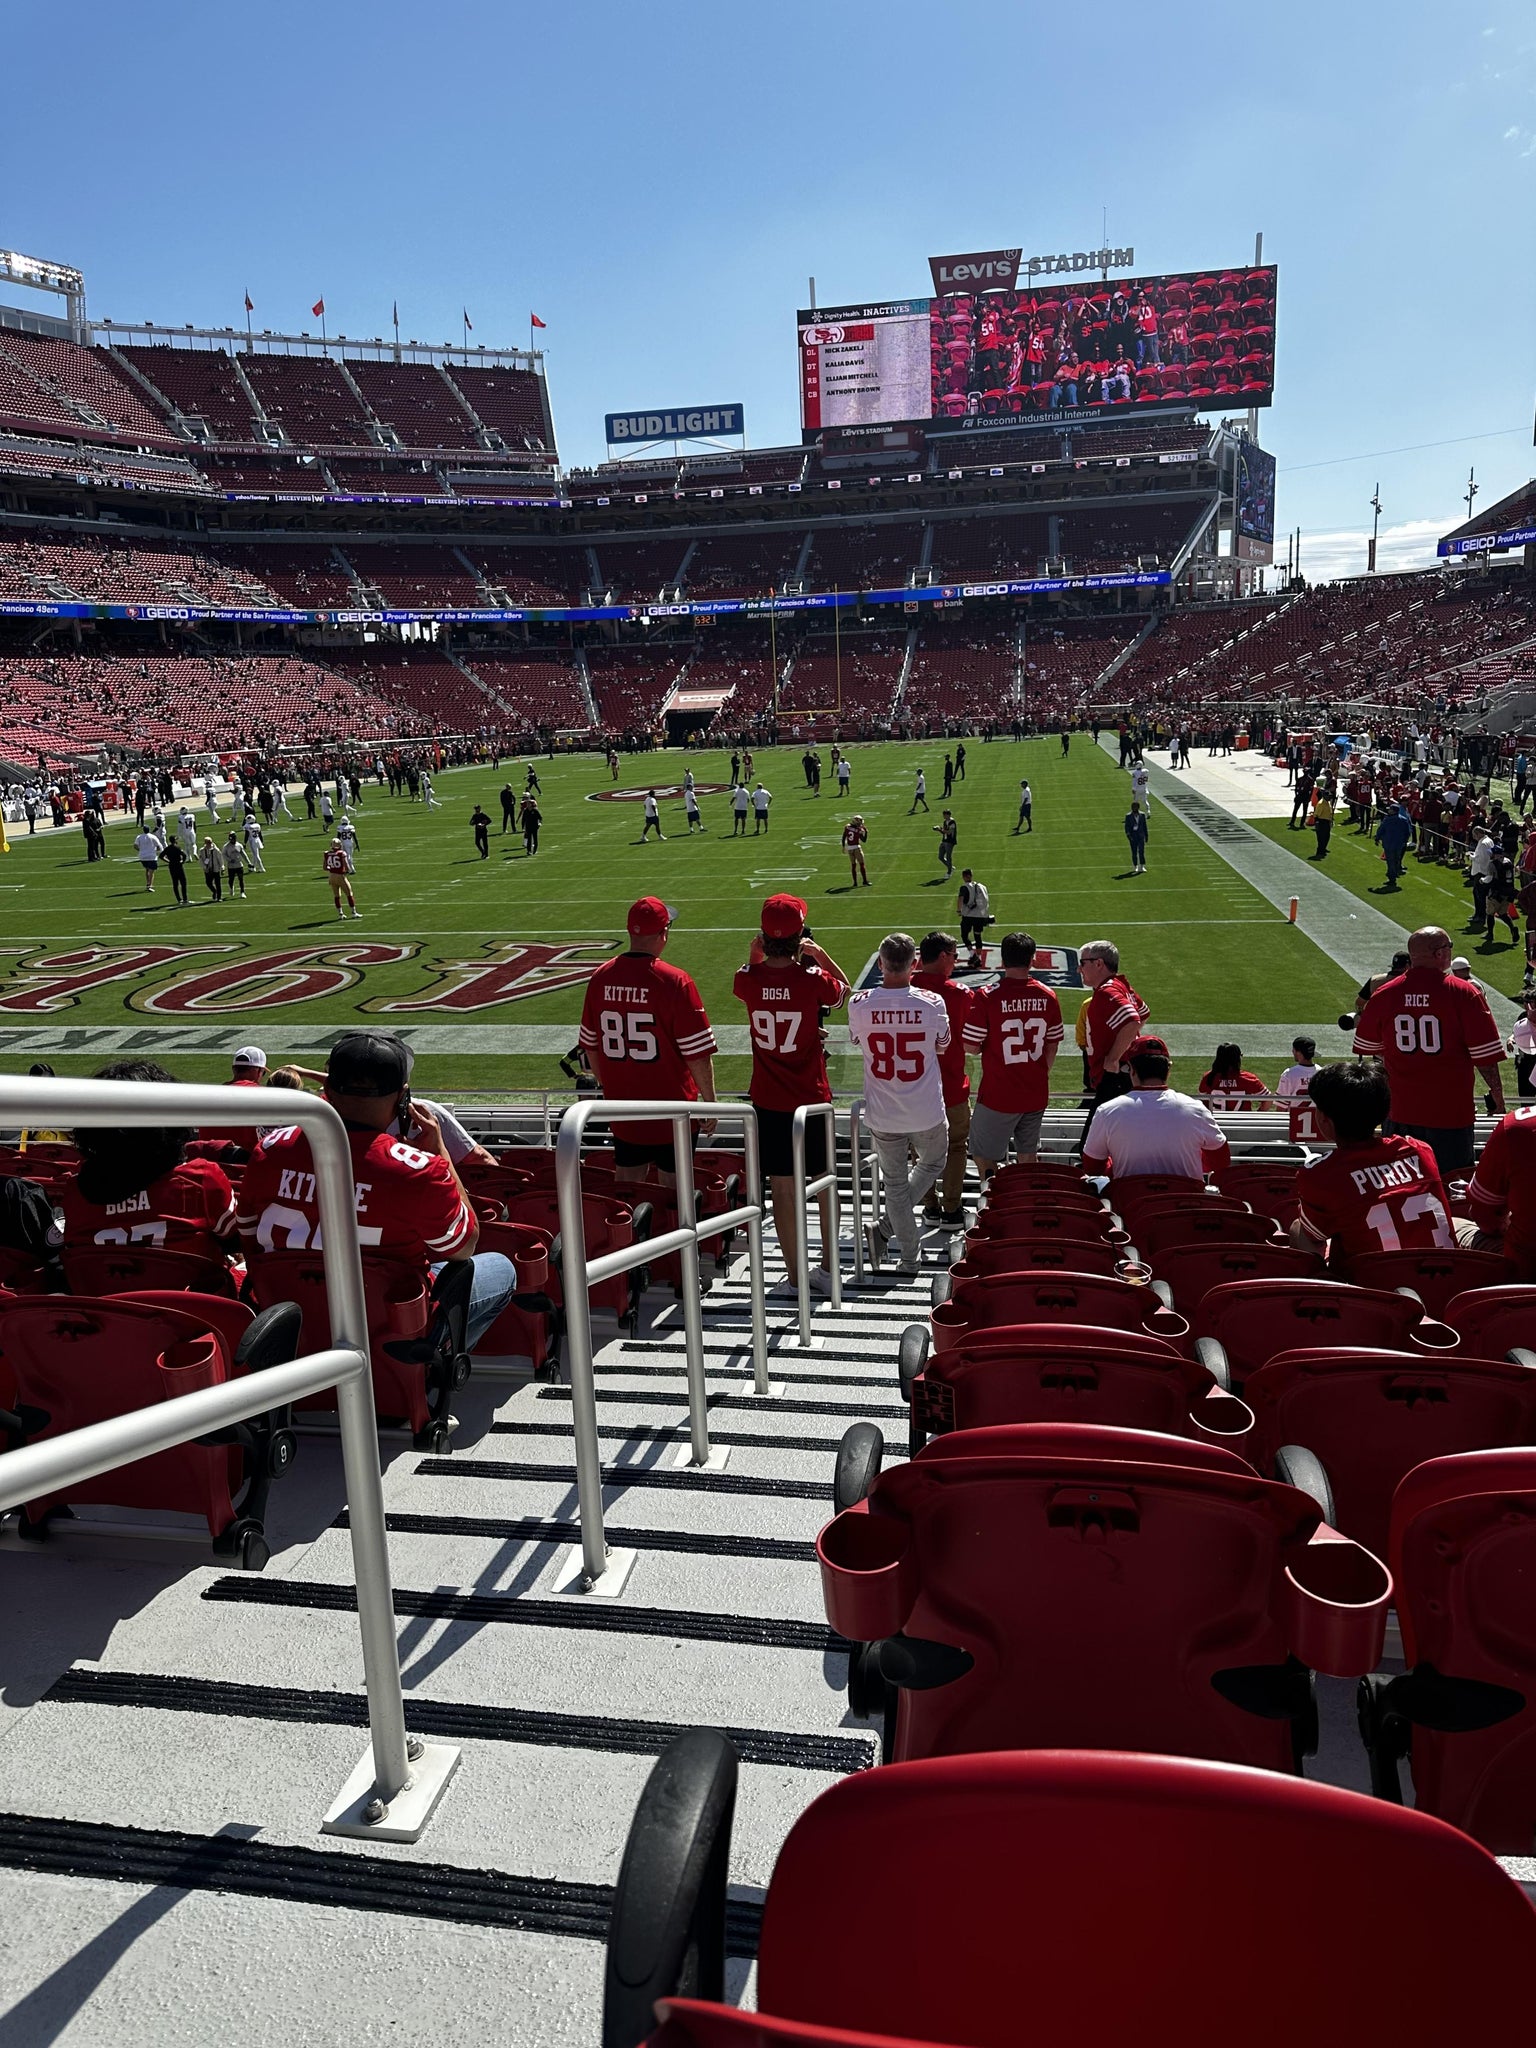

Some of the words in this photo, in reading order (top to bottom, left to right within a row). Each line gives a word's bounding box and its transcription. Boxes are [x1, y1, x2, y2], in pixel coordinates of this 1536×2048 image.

[1028, 247, 1134, 276] STADIUM
[824, 312, 842, 320] Dignity
[863, 305, 910, 317] INACTIVES
[845, 359, 865, 367] DAVIS
[848, 372, 879, 380] MITCHELL
[826, 388, 856, 396] ANTHONY
[857, 386, 880, 394] BROWN
[613, 418, 664, 438] BUD
[665, 410, 736, 434] LIGHT
[977, 416, 1017, 428] Foxconn
[1018, 411, 1063, 424] Industrial
[1064, 408, 1101, 420] Internet
[865, 427, 893, 435] STADIUM
[1461, 536, 1495, 551] GEICO
[1496, 533, 1514, 544] Proud
[963, 584, 1009, 597] GEICO
[1011, 583, 1032, 592] Proud
[1033, 580, 1061, 590] Partner
[1063, 580, 1071, 588] of
[1071, 579, 1085, 588] the
[1085, 578, 1100, 587] San
[1100, 575, 1136, 586] Francisco
[1136, 574, 1159, 584] 49ers
[36, 605, 59, 614] 49ers
[648, 604, 690, 616] GEICO
[692, 604, 712, 612] Proud
[713, 602, 738, 611] Partner
[739, 601, 748, 609] of
[748, 601, 759, 609] the
[760, 600, 773, 609] San
[774, 599, 805, 608] Francisco
[806, 597, 826, 606] 49ers
[944, 599, 963, 607] bank
[147, 607, 189, 619] GEICO
[191, 610, 210, 619] Proud
[211, 611, 233, 619] Partner
[234, 611, 242, 619] of
[242, 611, 252, 619] the
[253, 612, 264, 620] San
[265, 612, 291, 621] Francisco
[291, 613, 308, 621] 49ers
[337, 612, 384, 623] GEICO
[386, 612, 408, 620] Proud
[409, 611, 435, 620] Partner
[436, 611, 444, 619] of
[444, 611, 456, 620] the
[457, 611, 470, 619] San
[471, 611, 502, 620] Francisco
[503, 611, 523, 620] 49ers
[848, 831, 854, 841] 3
[327, 855, 342, 869] 46
[604, 985, 649, 1004] KITTLE
[762, 987, 791, 1001] BOSA
[1404, 993, 1430, 1008] RICE
[1001, 998, 1048, 1014] McCAFFREY
[871, 1010, 923, 1025] KITTLE
[600, 1010, 657, 1062] 85
[751, 1010, 802, 1054] 97
[1394, 1014, 1442, 1055] 80
[1001, 1017, 1048, 1065] 23
[867, 1032, 926, 1082] 85
[1351, 1155, 1424, 1196] PURDY
